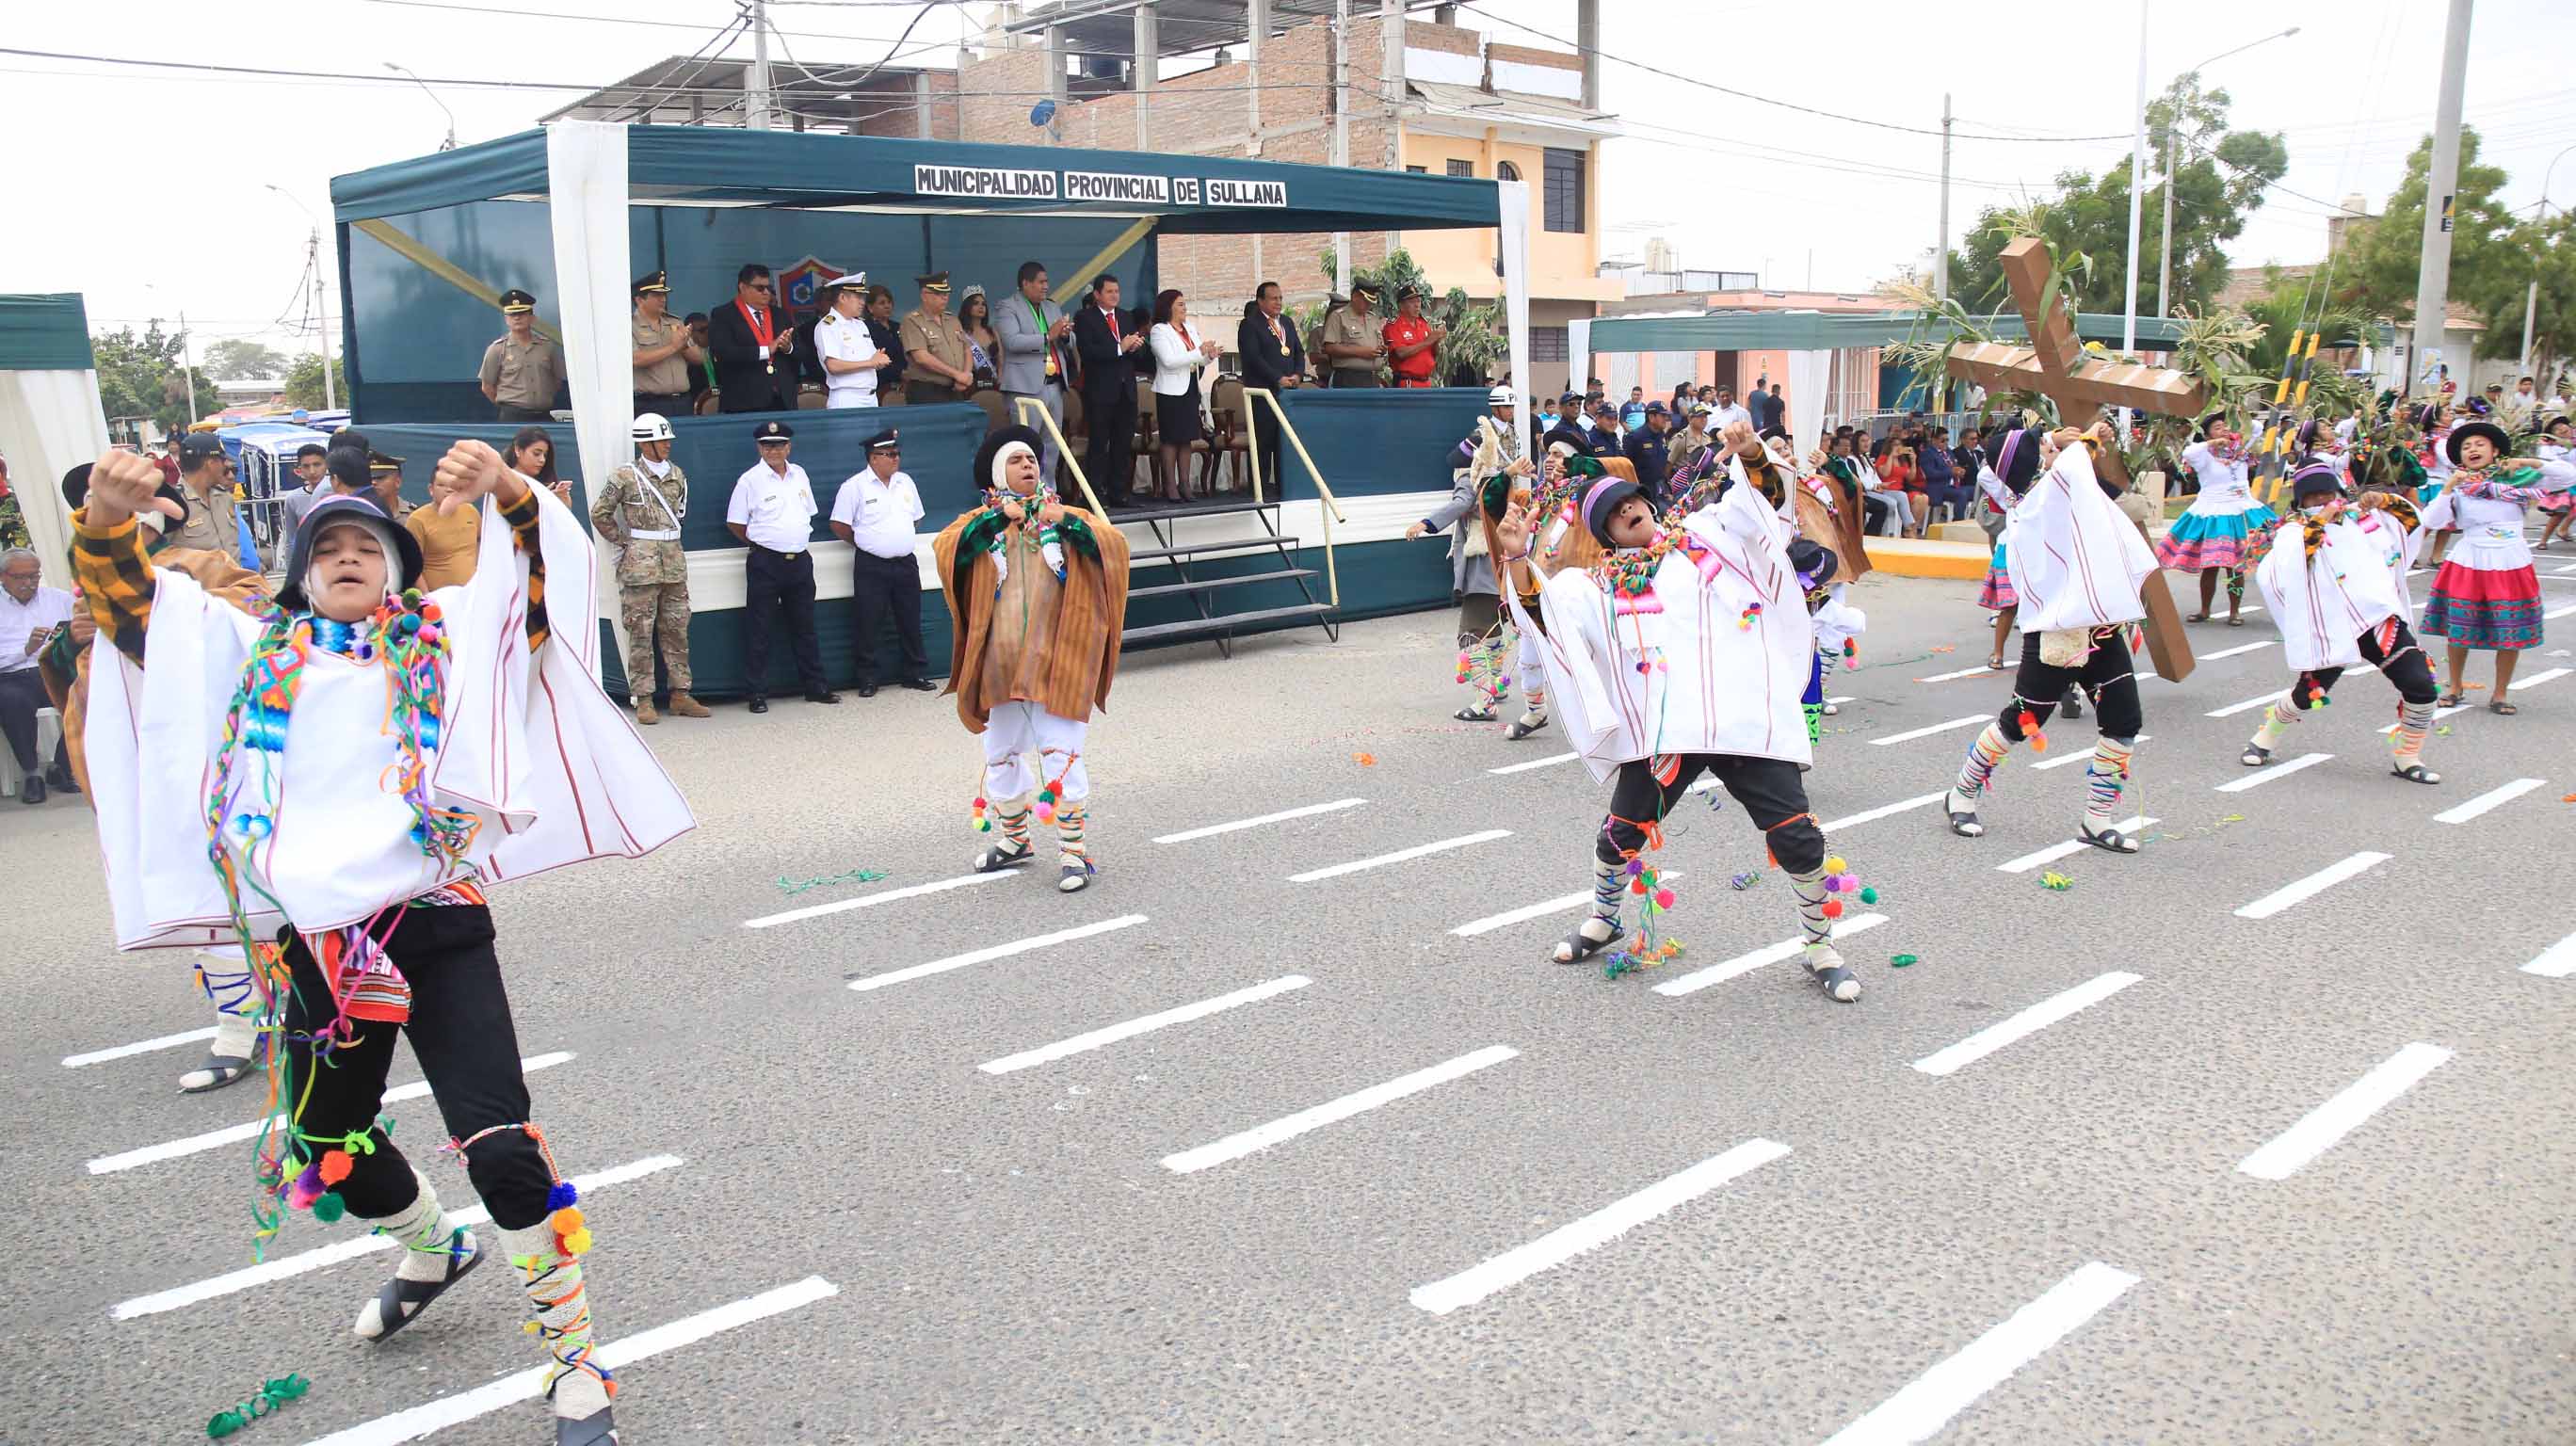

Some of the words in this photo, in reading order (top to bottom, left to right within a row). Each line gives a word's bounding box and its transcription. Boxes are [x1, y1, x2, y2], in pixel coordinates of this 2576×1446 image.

[917, 168, 1055, 196] MUNICIPALIDAD
[1068, 174, 1167, 201] PROVINCIAL
[1177, 181, 1199, 201] DE
[1211, 182, 1284, 204] SULLANA
